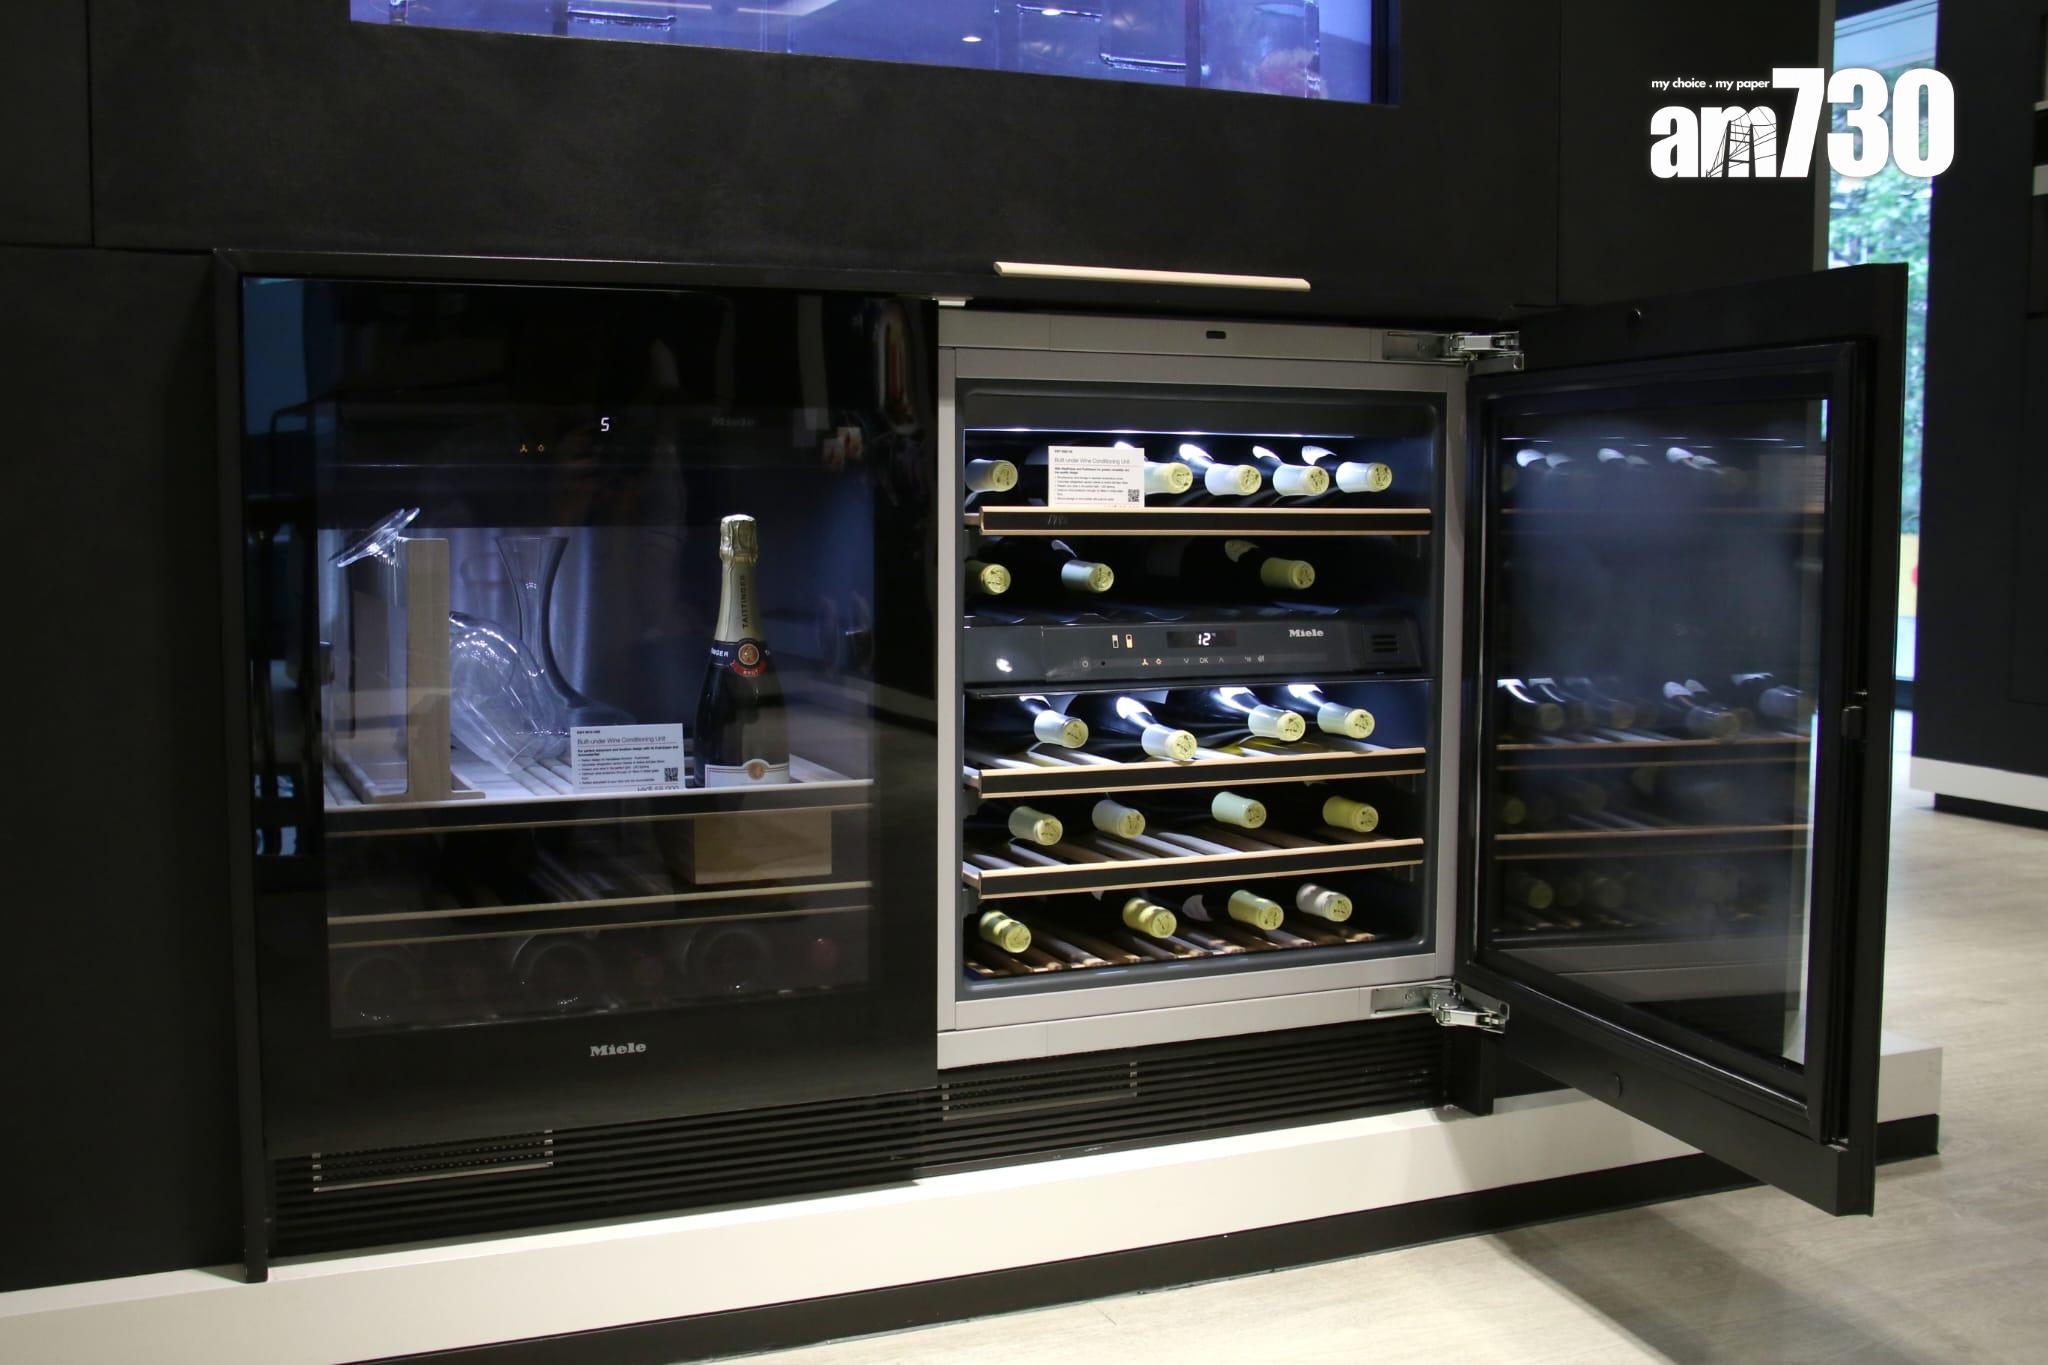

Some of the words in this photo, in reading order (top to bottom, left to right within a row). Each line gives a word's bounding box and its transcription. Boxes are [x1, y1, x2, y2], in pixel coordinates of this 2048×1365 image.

[600, 416, 610, 431] 5
[1288, 628, 1324, 638] Miele
[1199, 656, 1209, 664] OK
[621, 736, 654, 745] Conditioning
[589, 1042, 647, 1057] Miele
